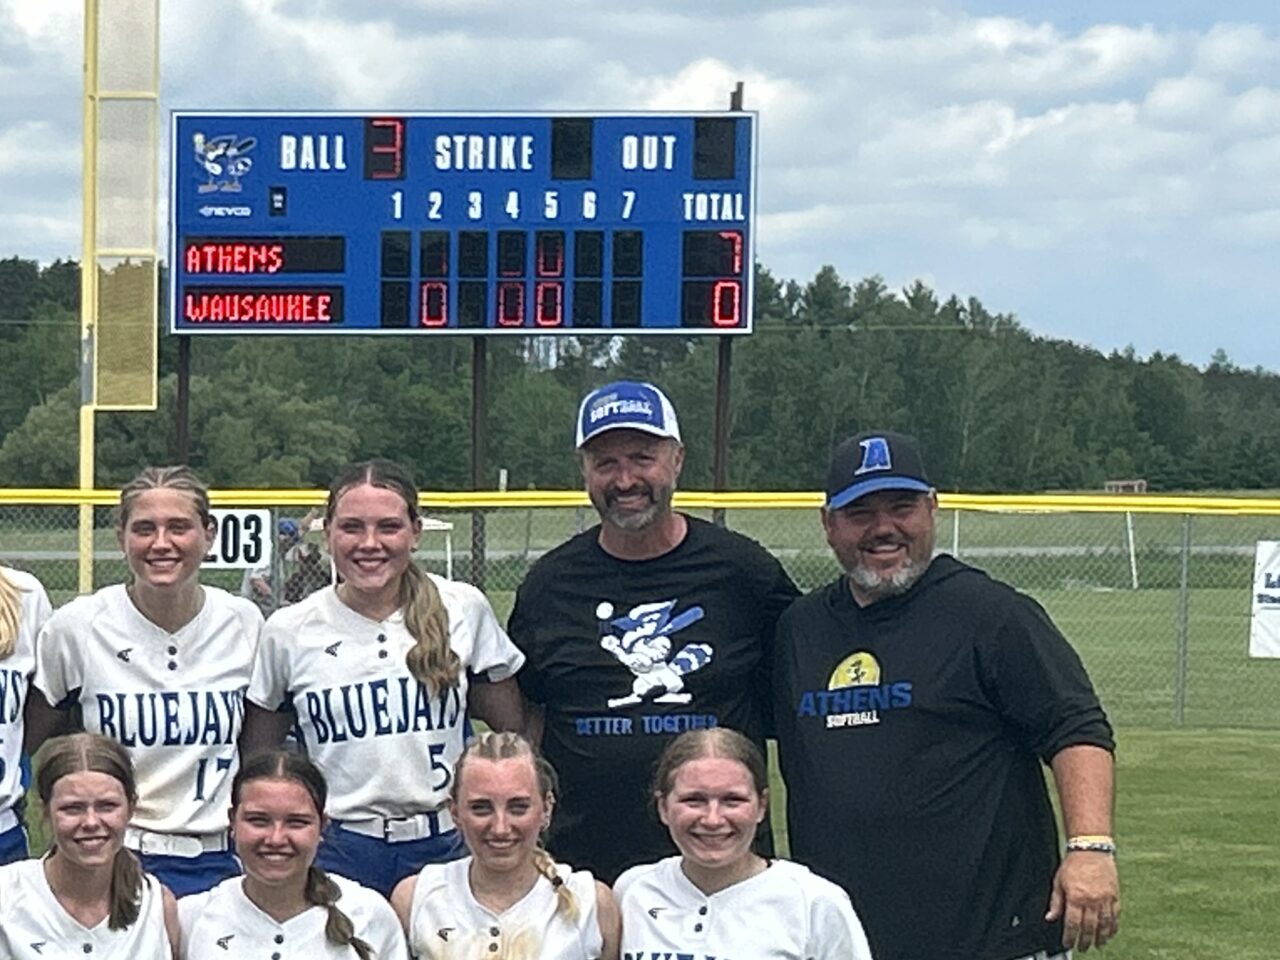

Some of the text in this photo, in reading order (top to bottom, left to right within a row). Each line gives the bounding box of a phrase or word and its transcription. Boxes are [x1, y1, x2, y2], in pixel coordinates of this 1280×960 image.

[280, 120, 676, 179] BALL 3 STRIKE OUT
[391, 191, 745, 221] 1 2 3 4 5 6 7 TOTAL
[186, 245, 284, 274] ATHENS
[719, 232, 741, 274] 7
[186, 281, 740, 326] WAUSAUKEE 0 0 0 0
[797, 682, 913, 717] ATHENS
[826, 710, 880, 728] SOFTBALL
[575, 715, 633, 735] BETTER
[193, 758, 233, 801] 17
[428, 743, 451, 792] 5
